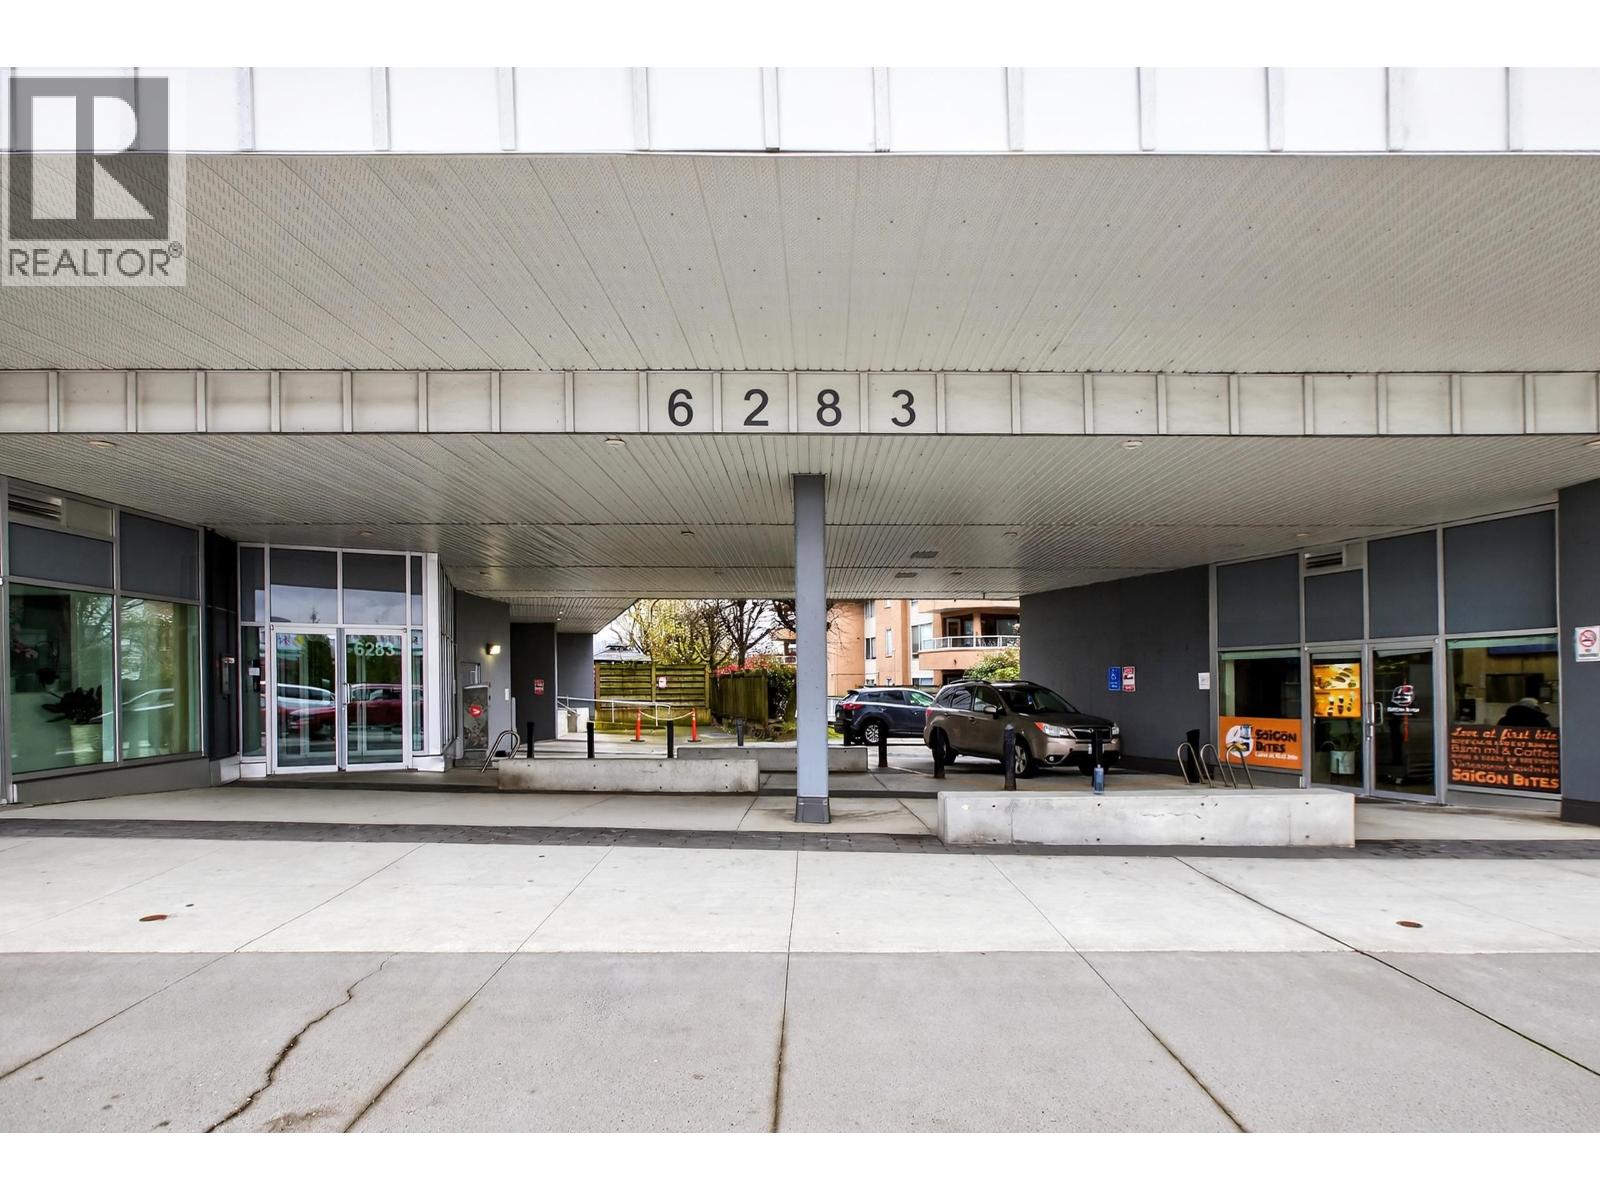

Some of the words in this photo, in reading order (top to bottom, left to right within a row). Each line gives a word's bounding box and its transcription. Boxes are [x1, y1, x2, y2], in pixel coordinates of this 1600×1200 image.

[354, 639, 395, 656] 6283
[1483, 728, 1496, 738] at
[1501, 747, 1511, 756] &
[1514, 747, 1559, 758] Coffee
